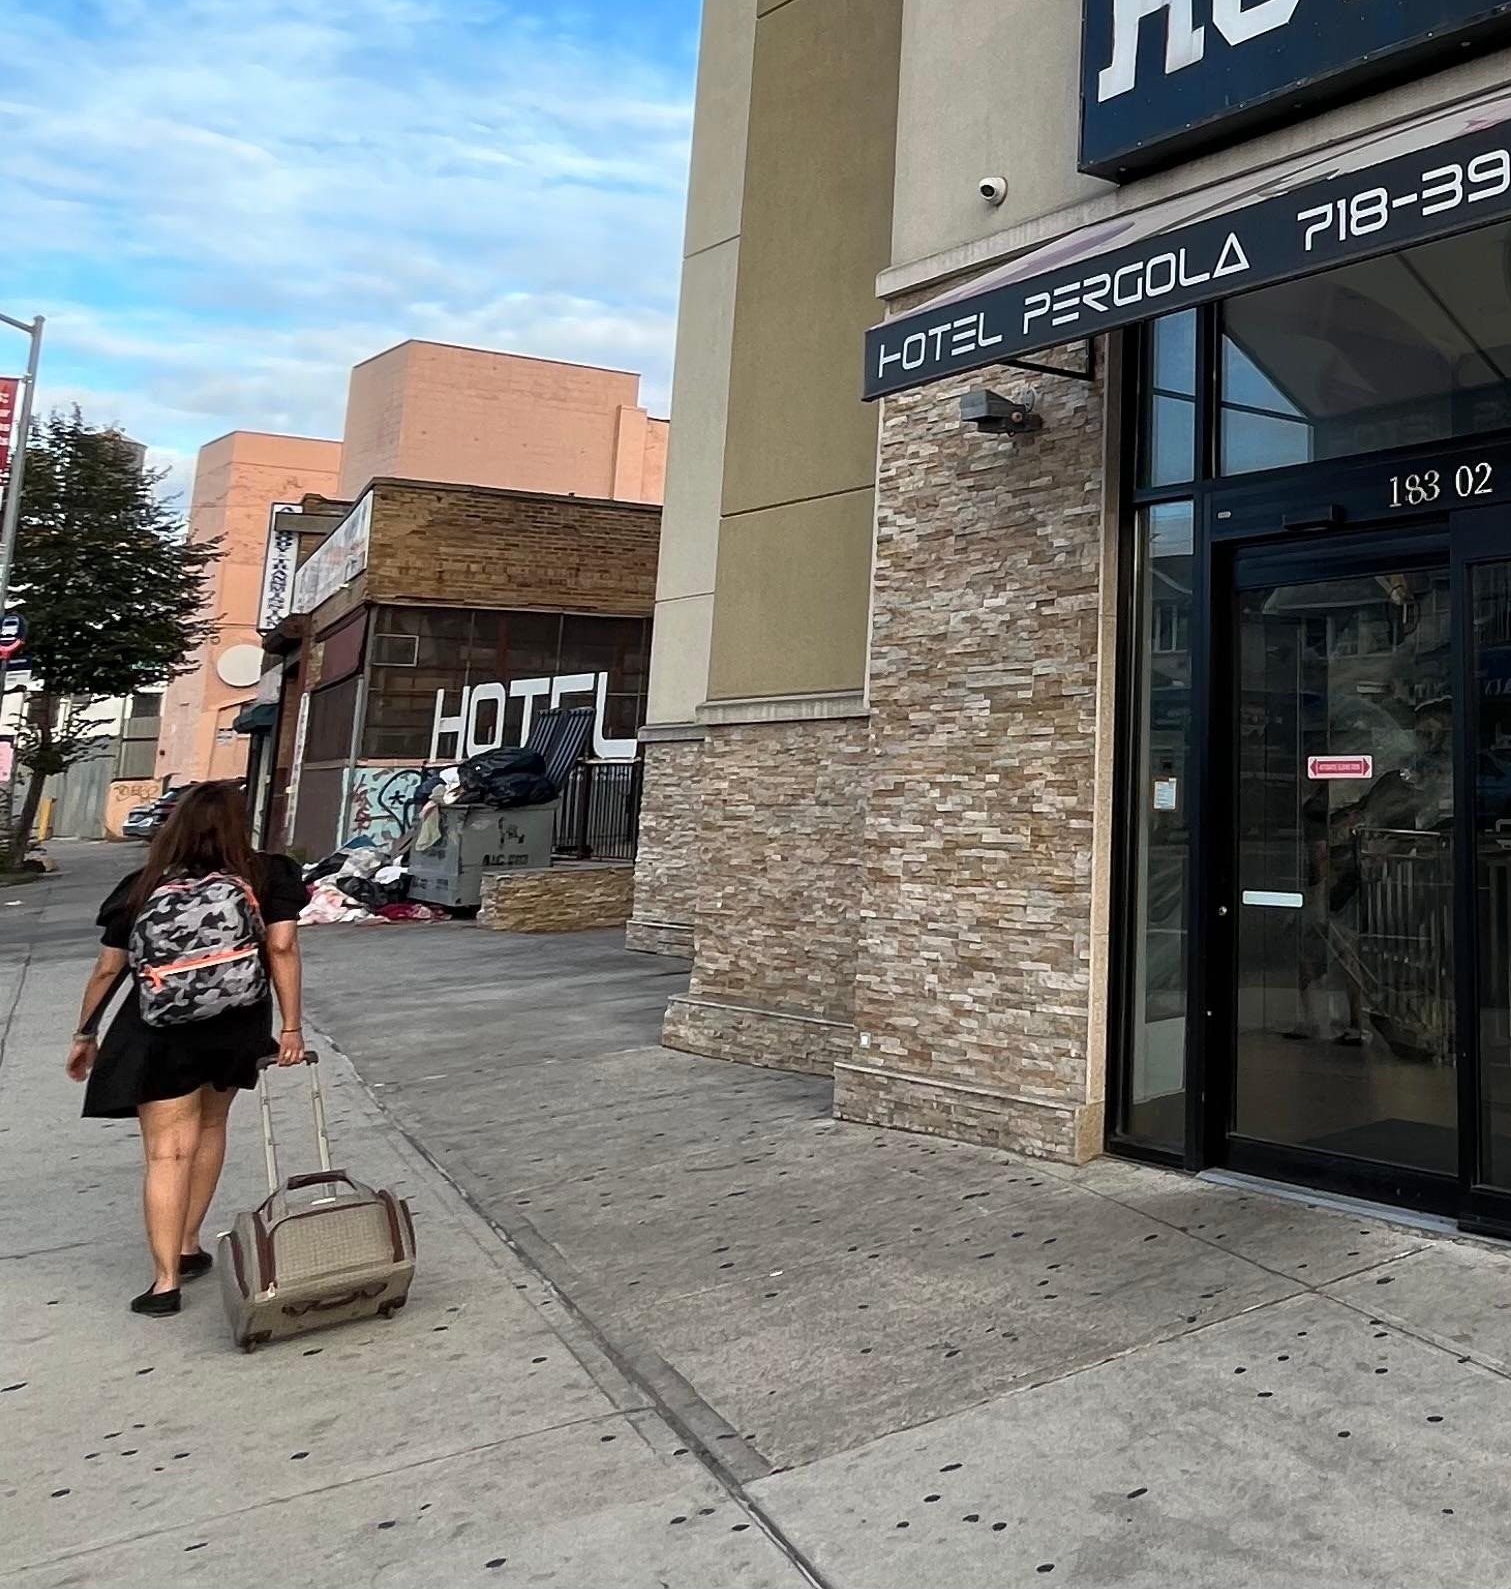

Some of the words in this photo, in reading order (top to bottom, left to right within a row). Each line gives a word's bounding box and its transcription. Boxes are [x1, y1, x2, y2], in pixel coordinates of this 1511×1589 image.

[878, 312, 1003, 379] HOTEL
[1023, 232, 1250, 336] PERGOLA
[1389, 470, 1441, 508] 183
[1455, 462, 1493, 497] 02
